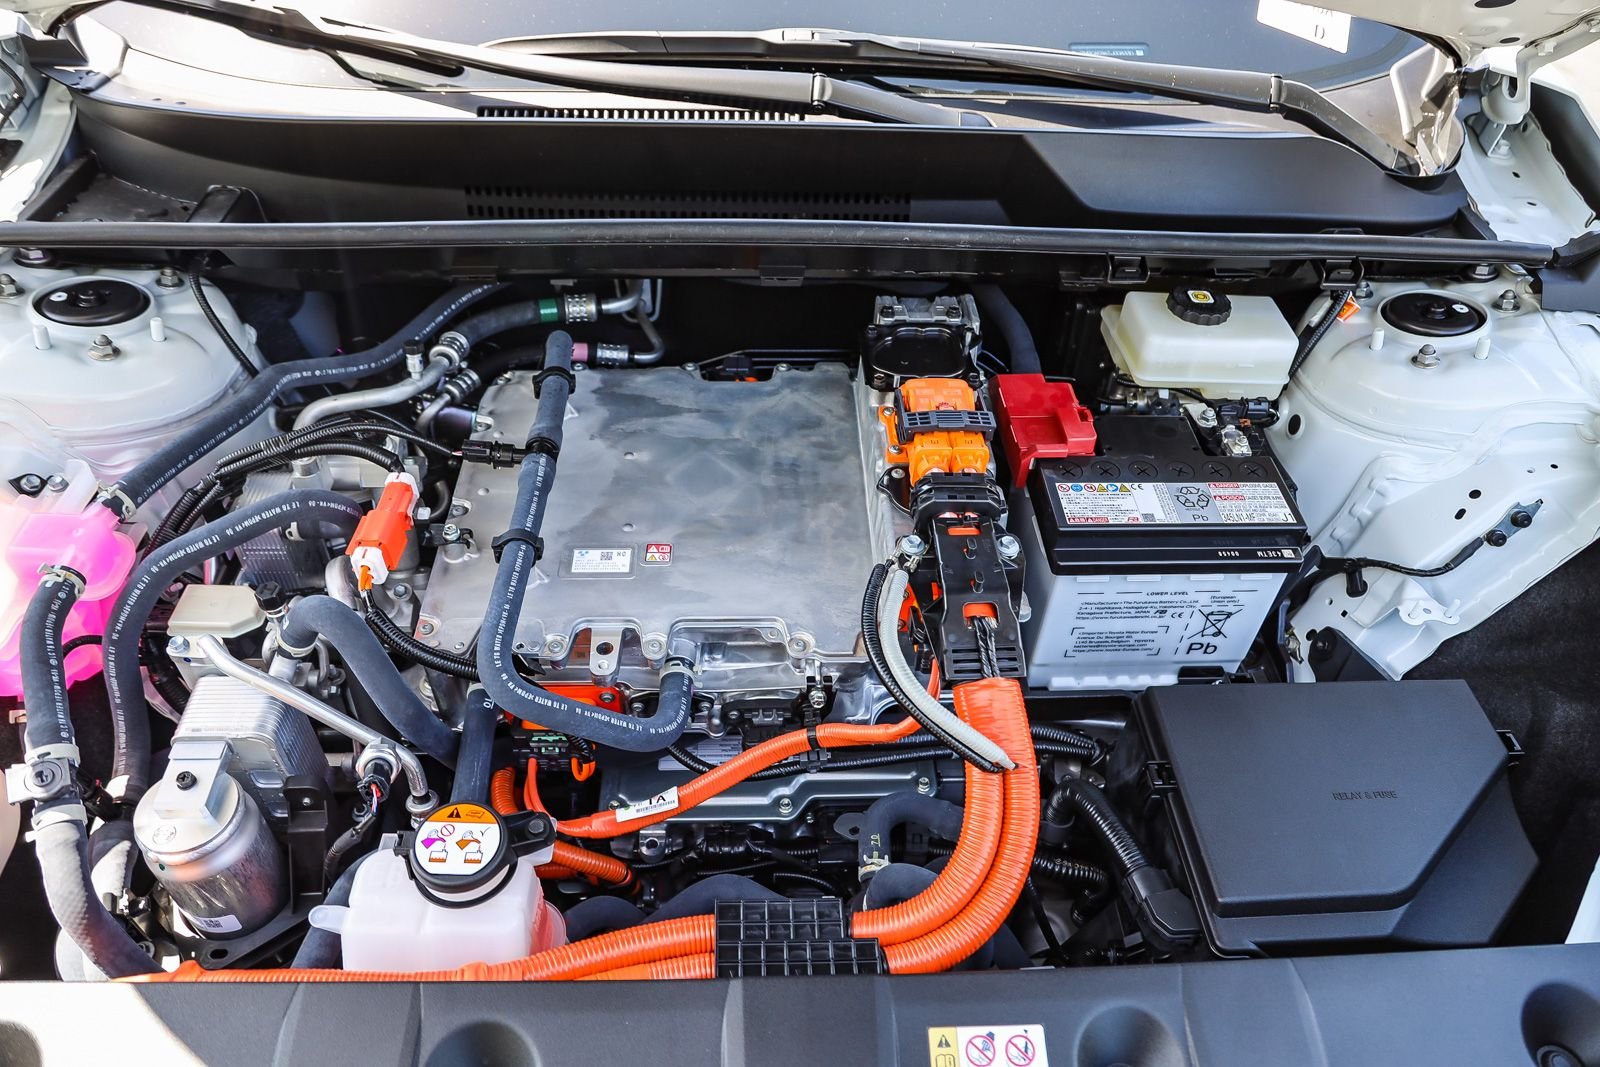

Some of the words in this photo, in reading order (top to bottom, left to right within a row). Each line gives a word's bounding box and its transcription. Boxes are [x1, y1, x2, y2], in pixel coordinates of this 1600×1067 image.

[1186, 642, 1217, 654] Pb
[1332, 792, 1362, 800] RELAY
[1372, 791, 1398, 799] FUSE
